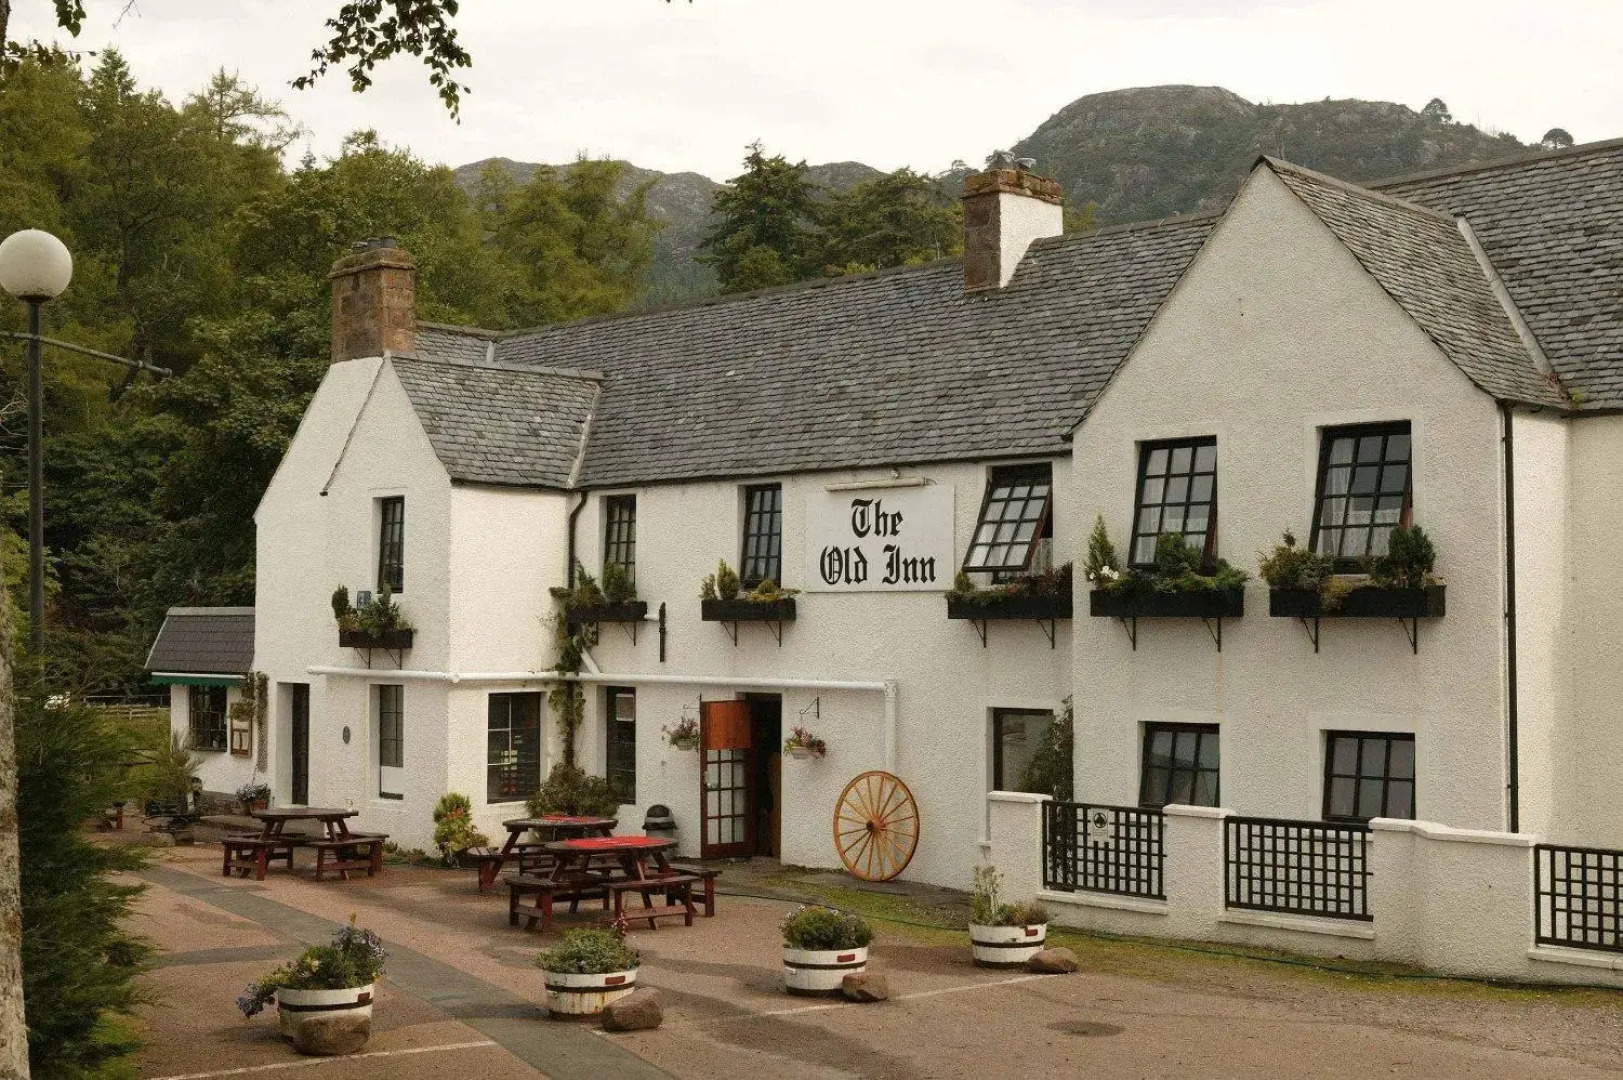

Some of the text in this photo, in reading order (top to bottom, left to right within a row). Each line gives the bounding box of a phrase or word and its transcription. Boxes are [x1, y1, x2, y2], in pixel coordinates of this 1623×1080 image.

[851, 498, 904, 538] The
[819, 544, 936, 585] Old Inn
